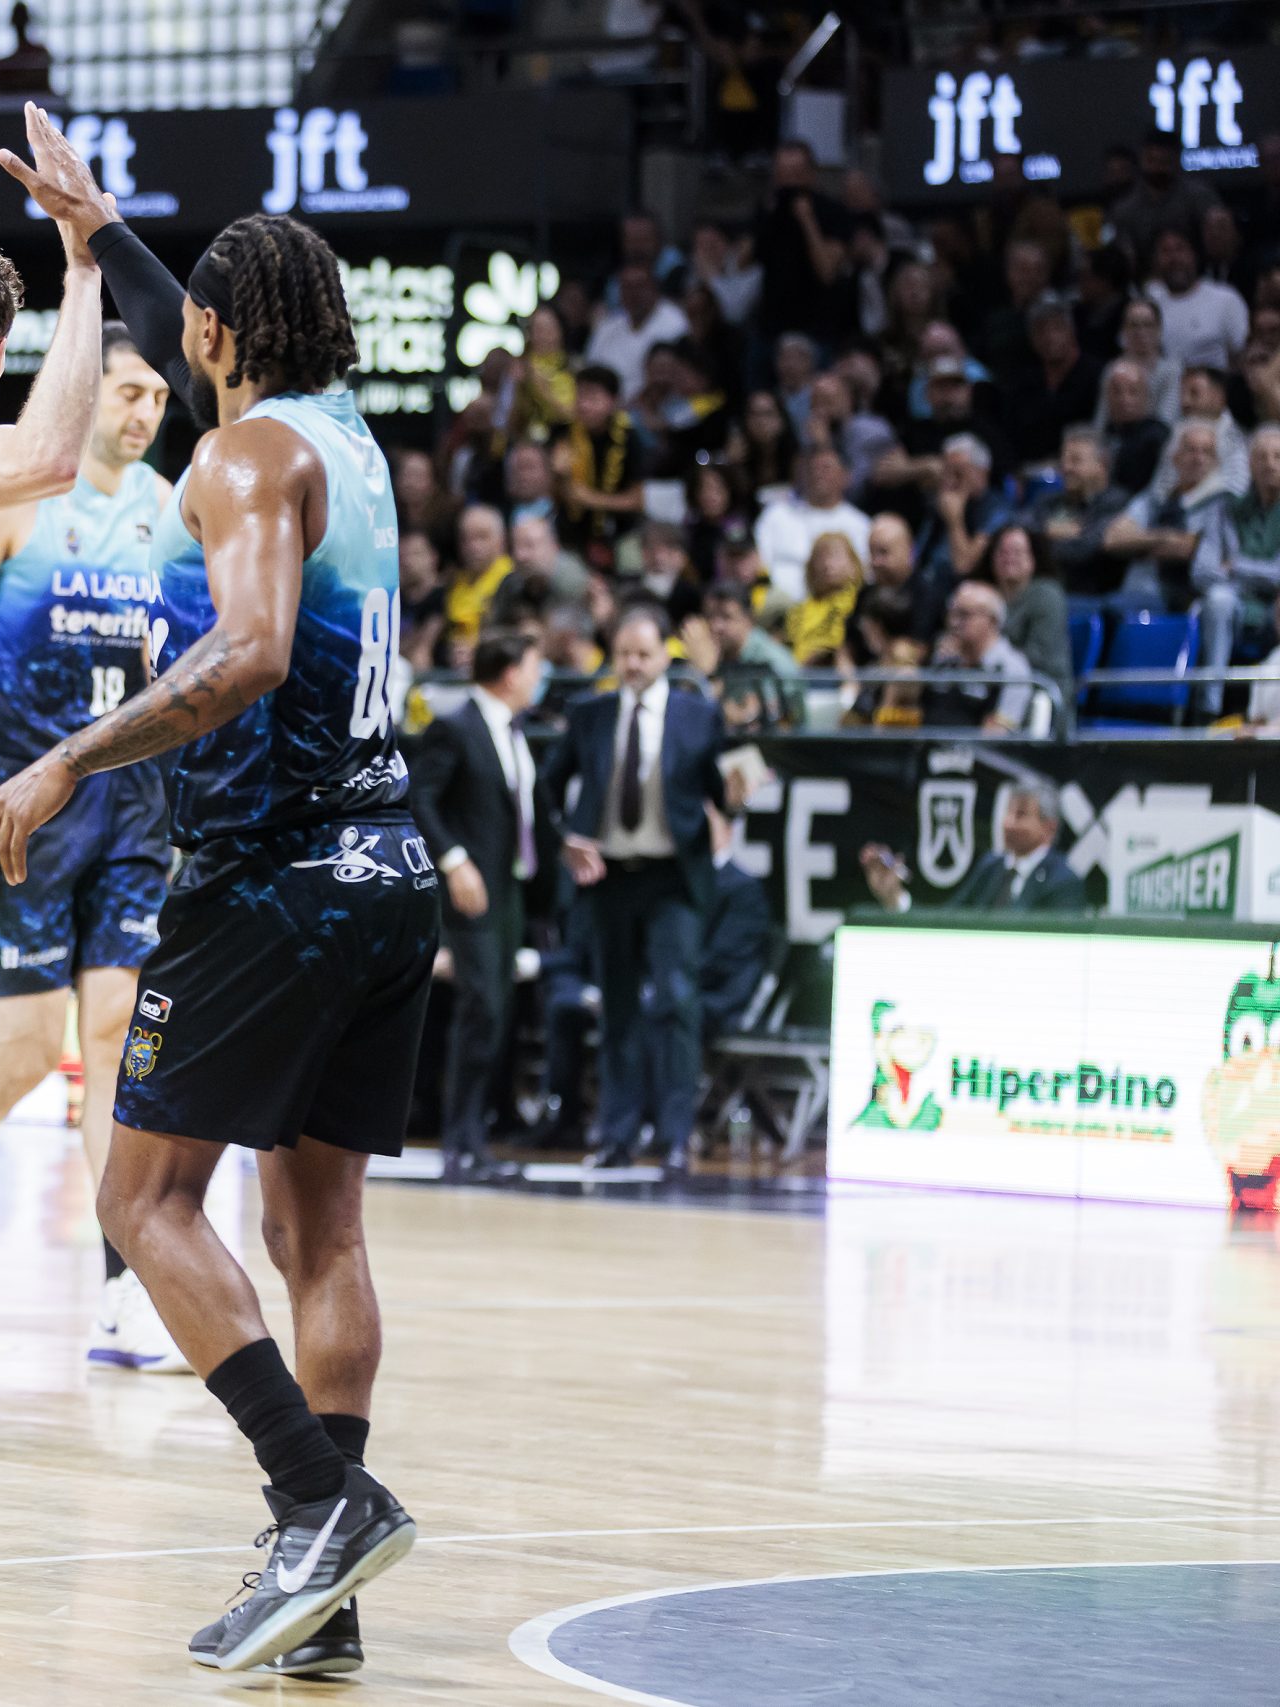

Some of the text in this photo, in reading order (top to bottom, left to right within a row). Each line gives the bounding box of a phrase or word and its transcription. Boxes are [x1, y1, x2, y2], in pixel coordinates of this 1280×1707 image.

[262, 107, 369, 214] jft
[923, 71, 1022, 186] jft
[52, 569, 89, 598] LA
[950, 1056, 1178, 1117] HiperDino
